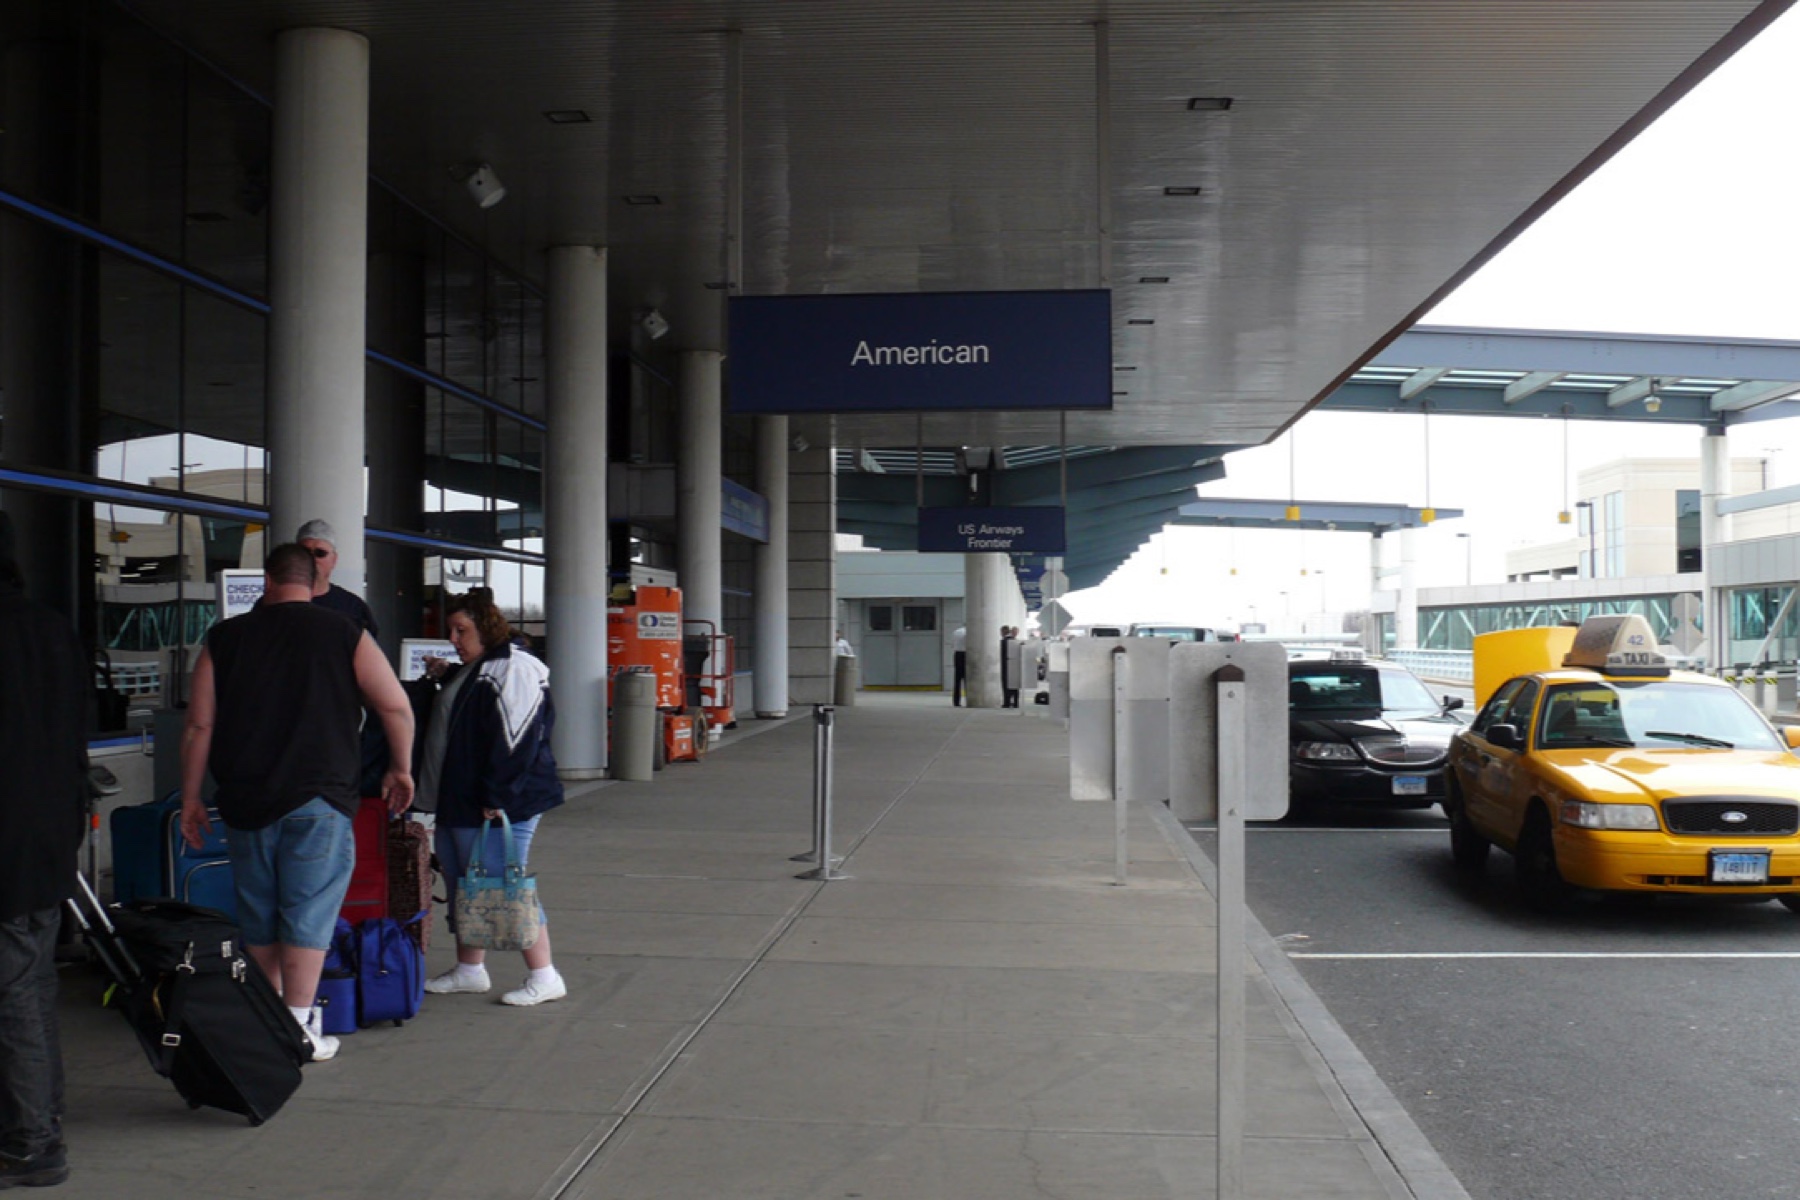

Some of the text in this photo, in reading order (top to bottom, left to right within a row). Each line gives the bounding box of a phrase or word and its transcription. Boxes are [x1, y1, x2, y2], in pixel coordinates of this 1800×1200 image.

[850, 338, 990, 366] American
[957, 523, 1025, 537] US Airways
[967, 536, 1013, 548] Frontier
[1626, 634, 1645, 646] 42
[1623, 652, 1650, 666] TAXI
